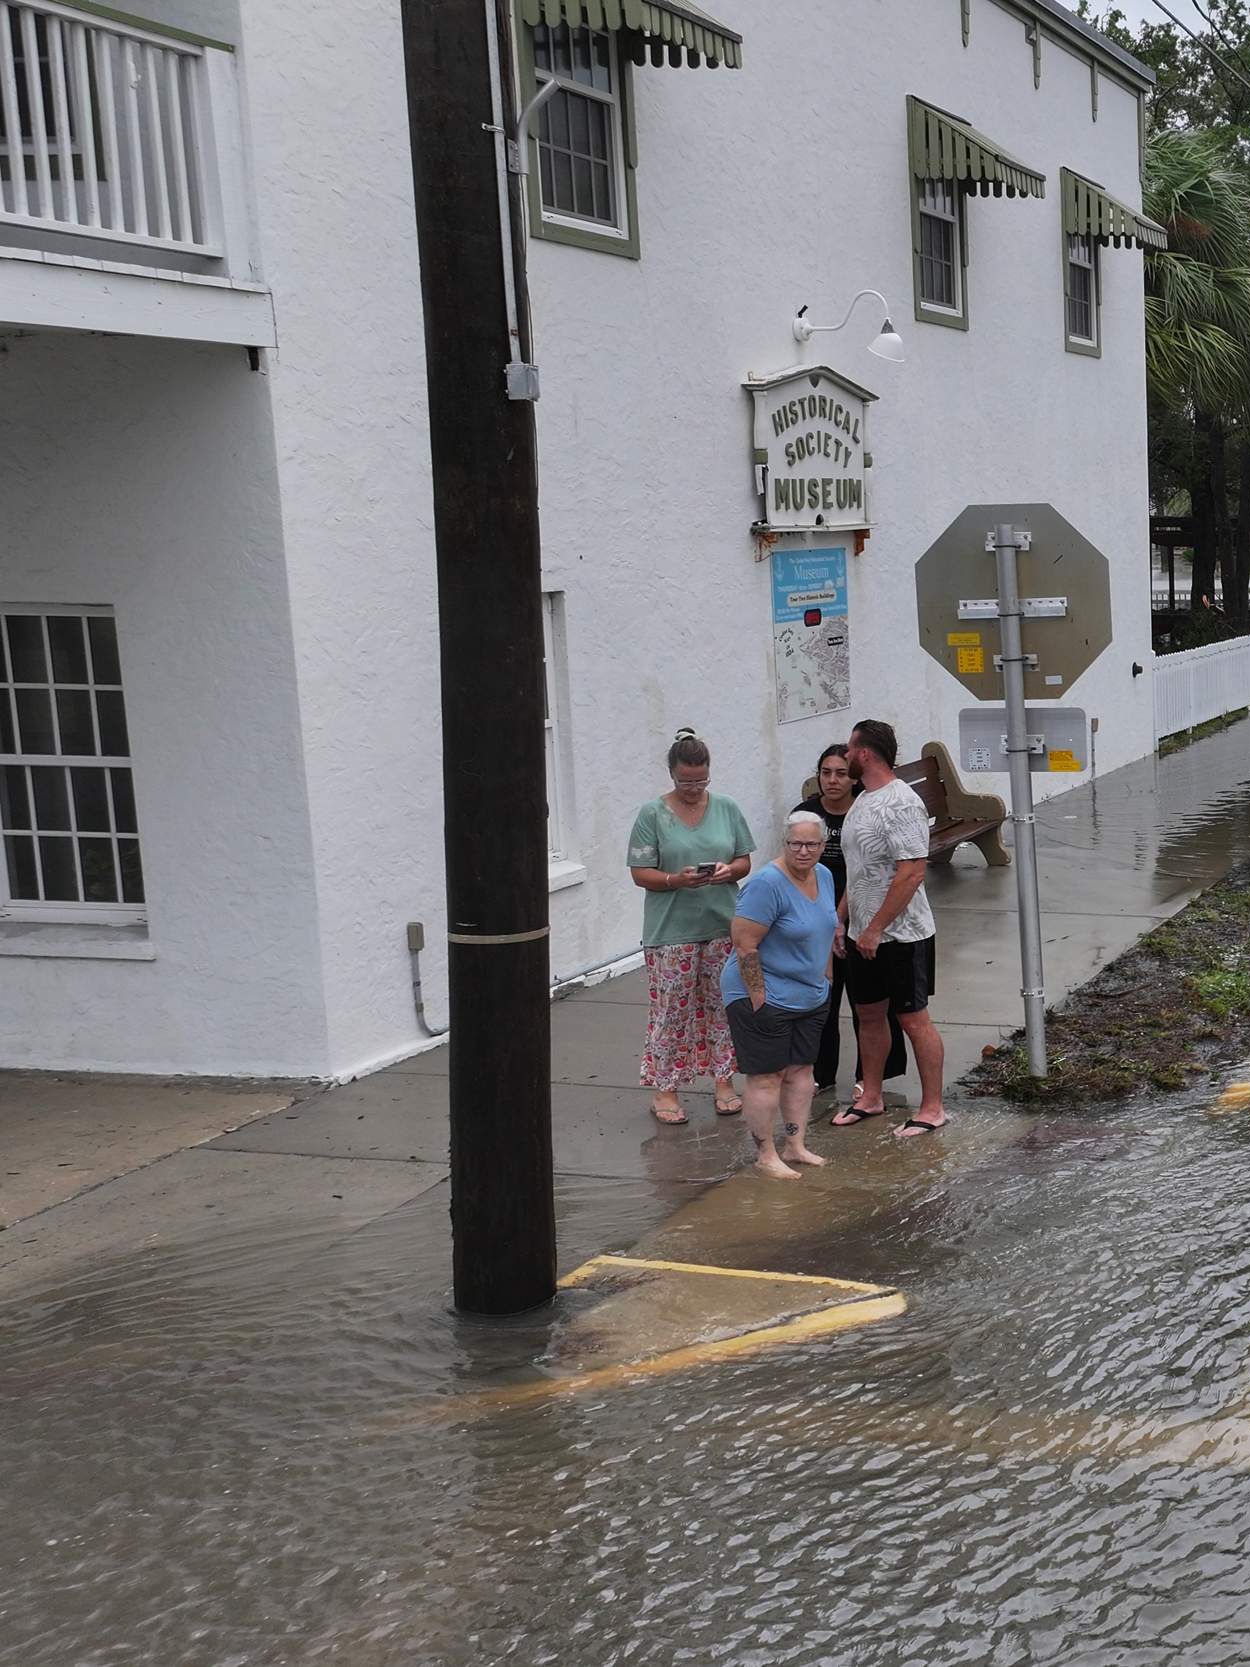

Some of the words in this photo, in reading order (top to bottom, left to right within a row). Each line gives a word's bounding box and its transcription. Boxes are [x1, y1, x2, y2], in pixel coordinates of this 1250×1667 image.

[772, 394, 861, 444] HISTORICAL
[785, 430, 852, 468] SOCIETY
[774, 478, 862, 511] MUSEUM
[794, 565, 830, 580] Museum
